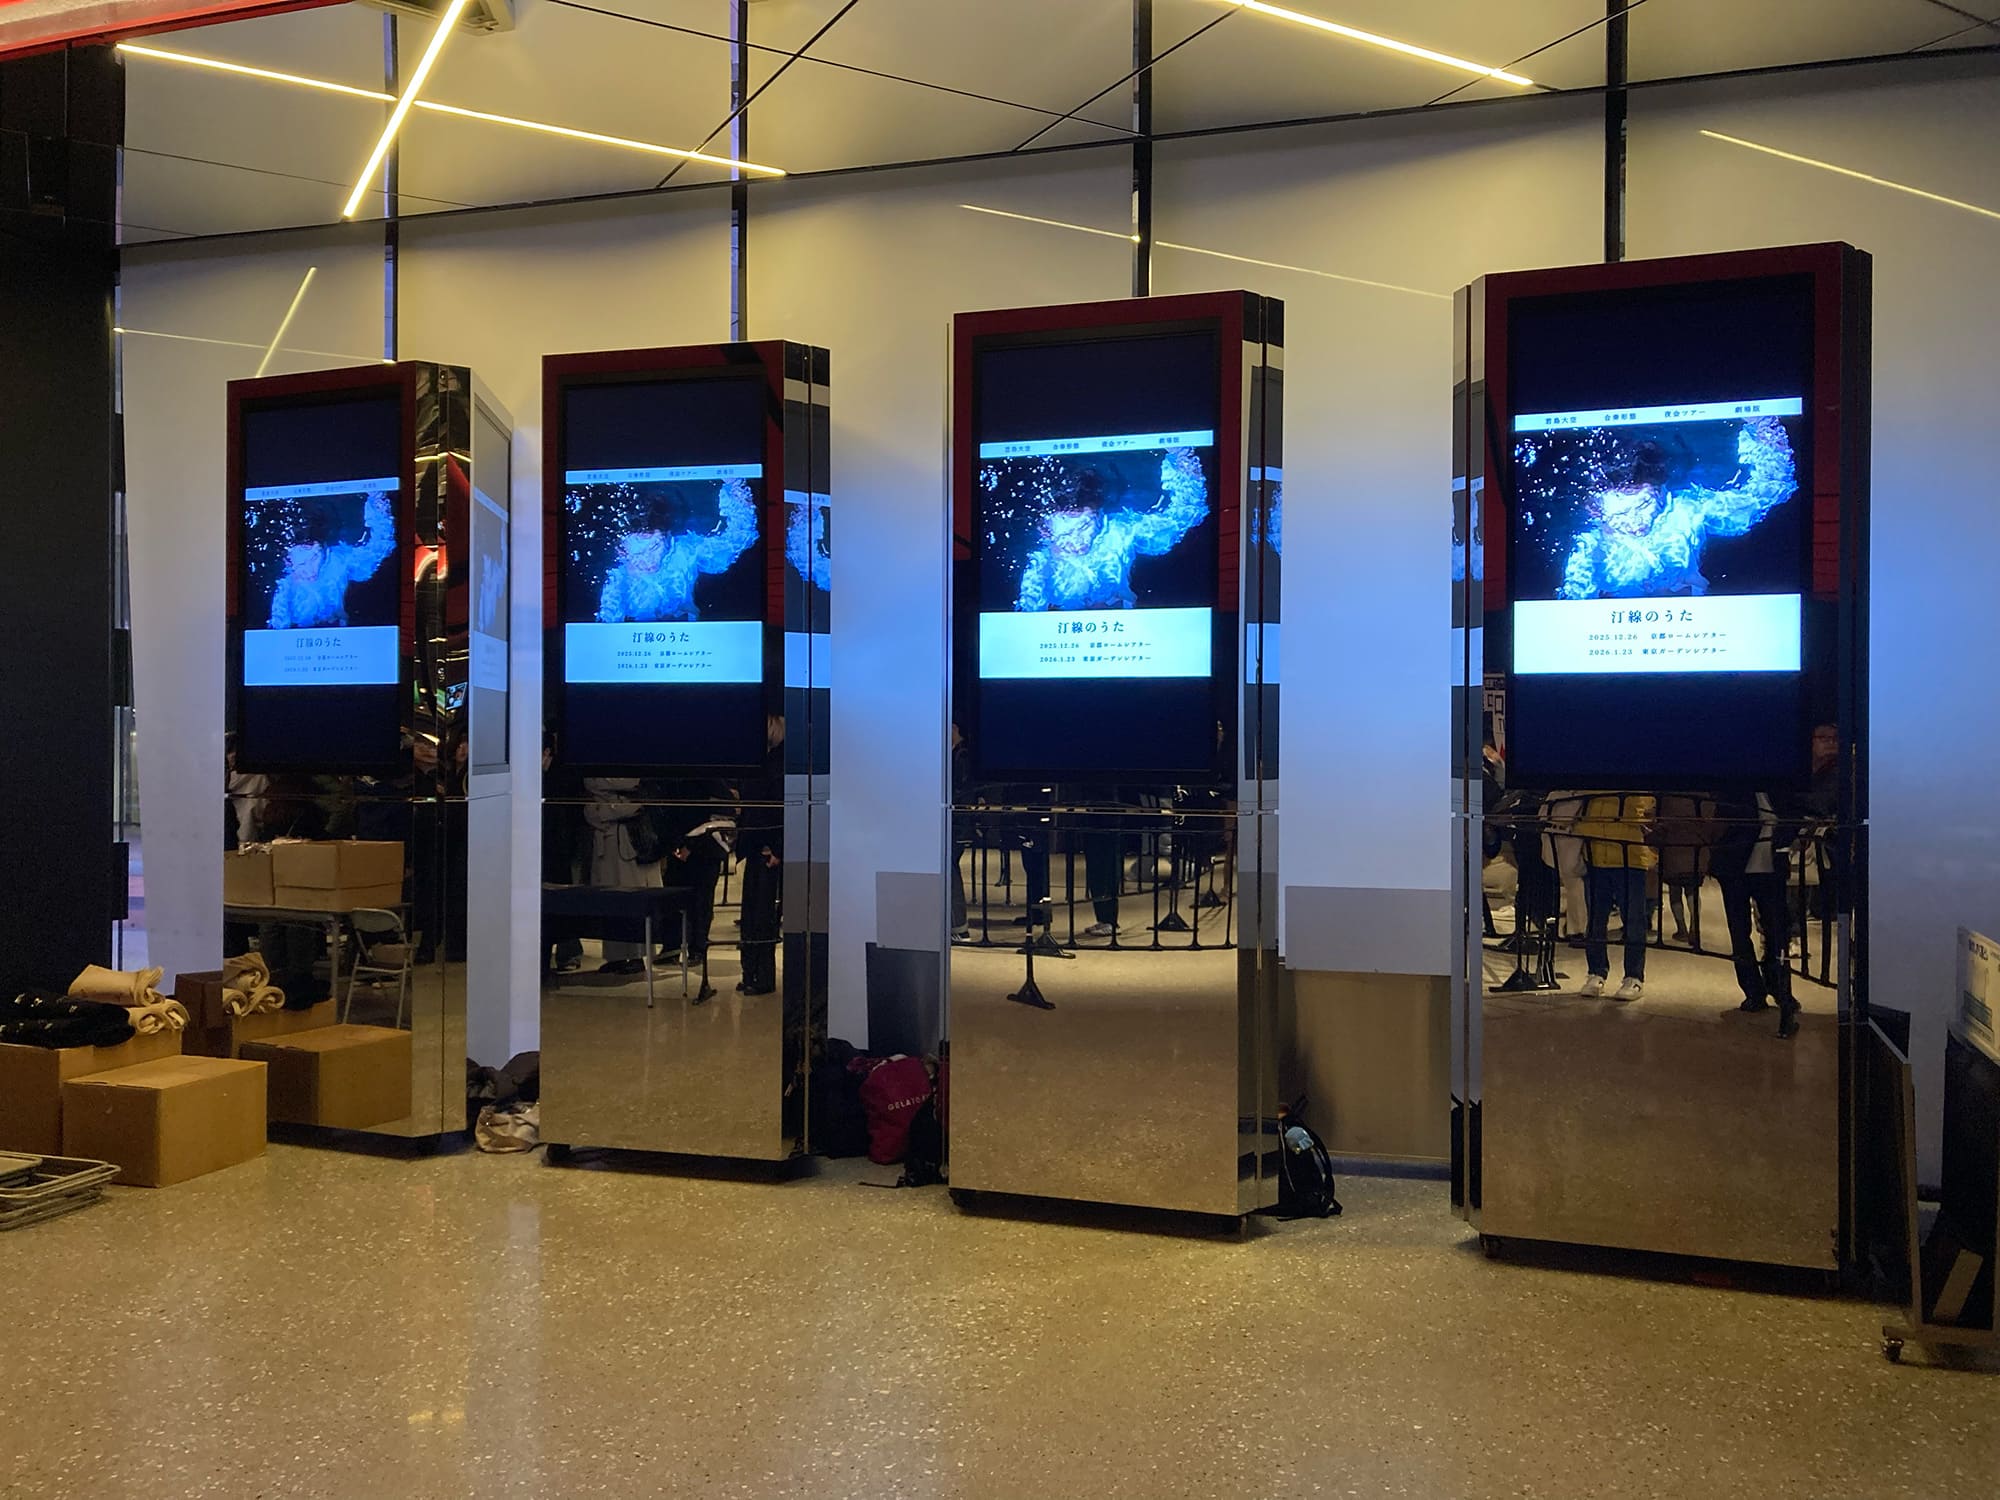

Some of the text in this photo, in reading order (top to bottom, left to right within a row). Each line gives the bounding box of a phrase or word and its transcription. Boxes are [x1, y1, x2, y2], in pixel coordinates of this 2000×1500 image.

[1611, 609, 1694, 624] 汀線のうた
[1057, 620, 1125, 634] 汀線のうた
[1588, 648, 1633, 656] 2026.1.23
